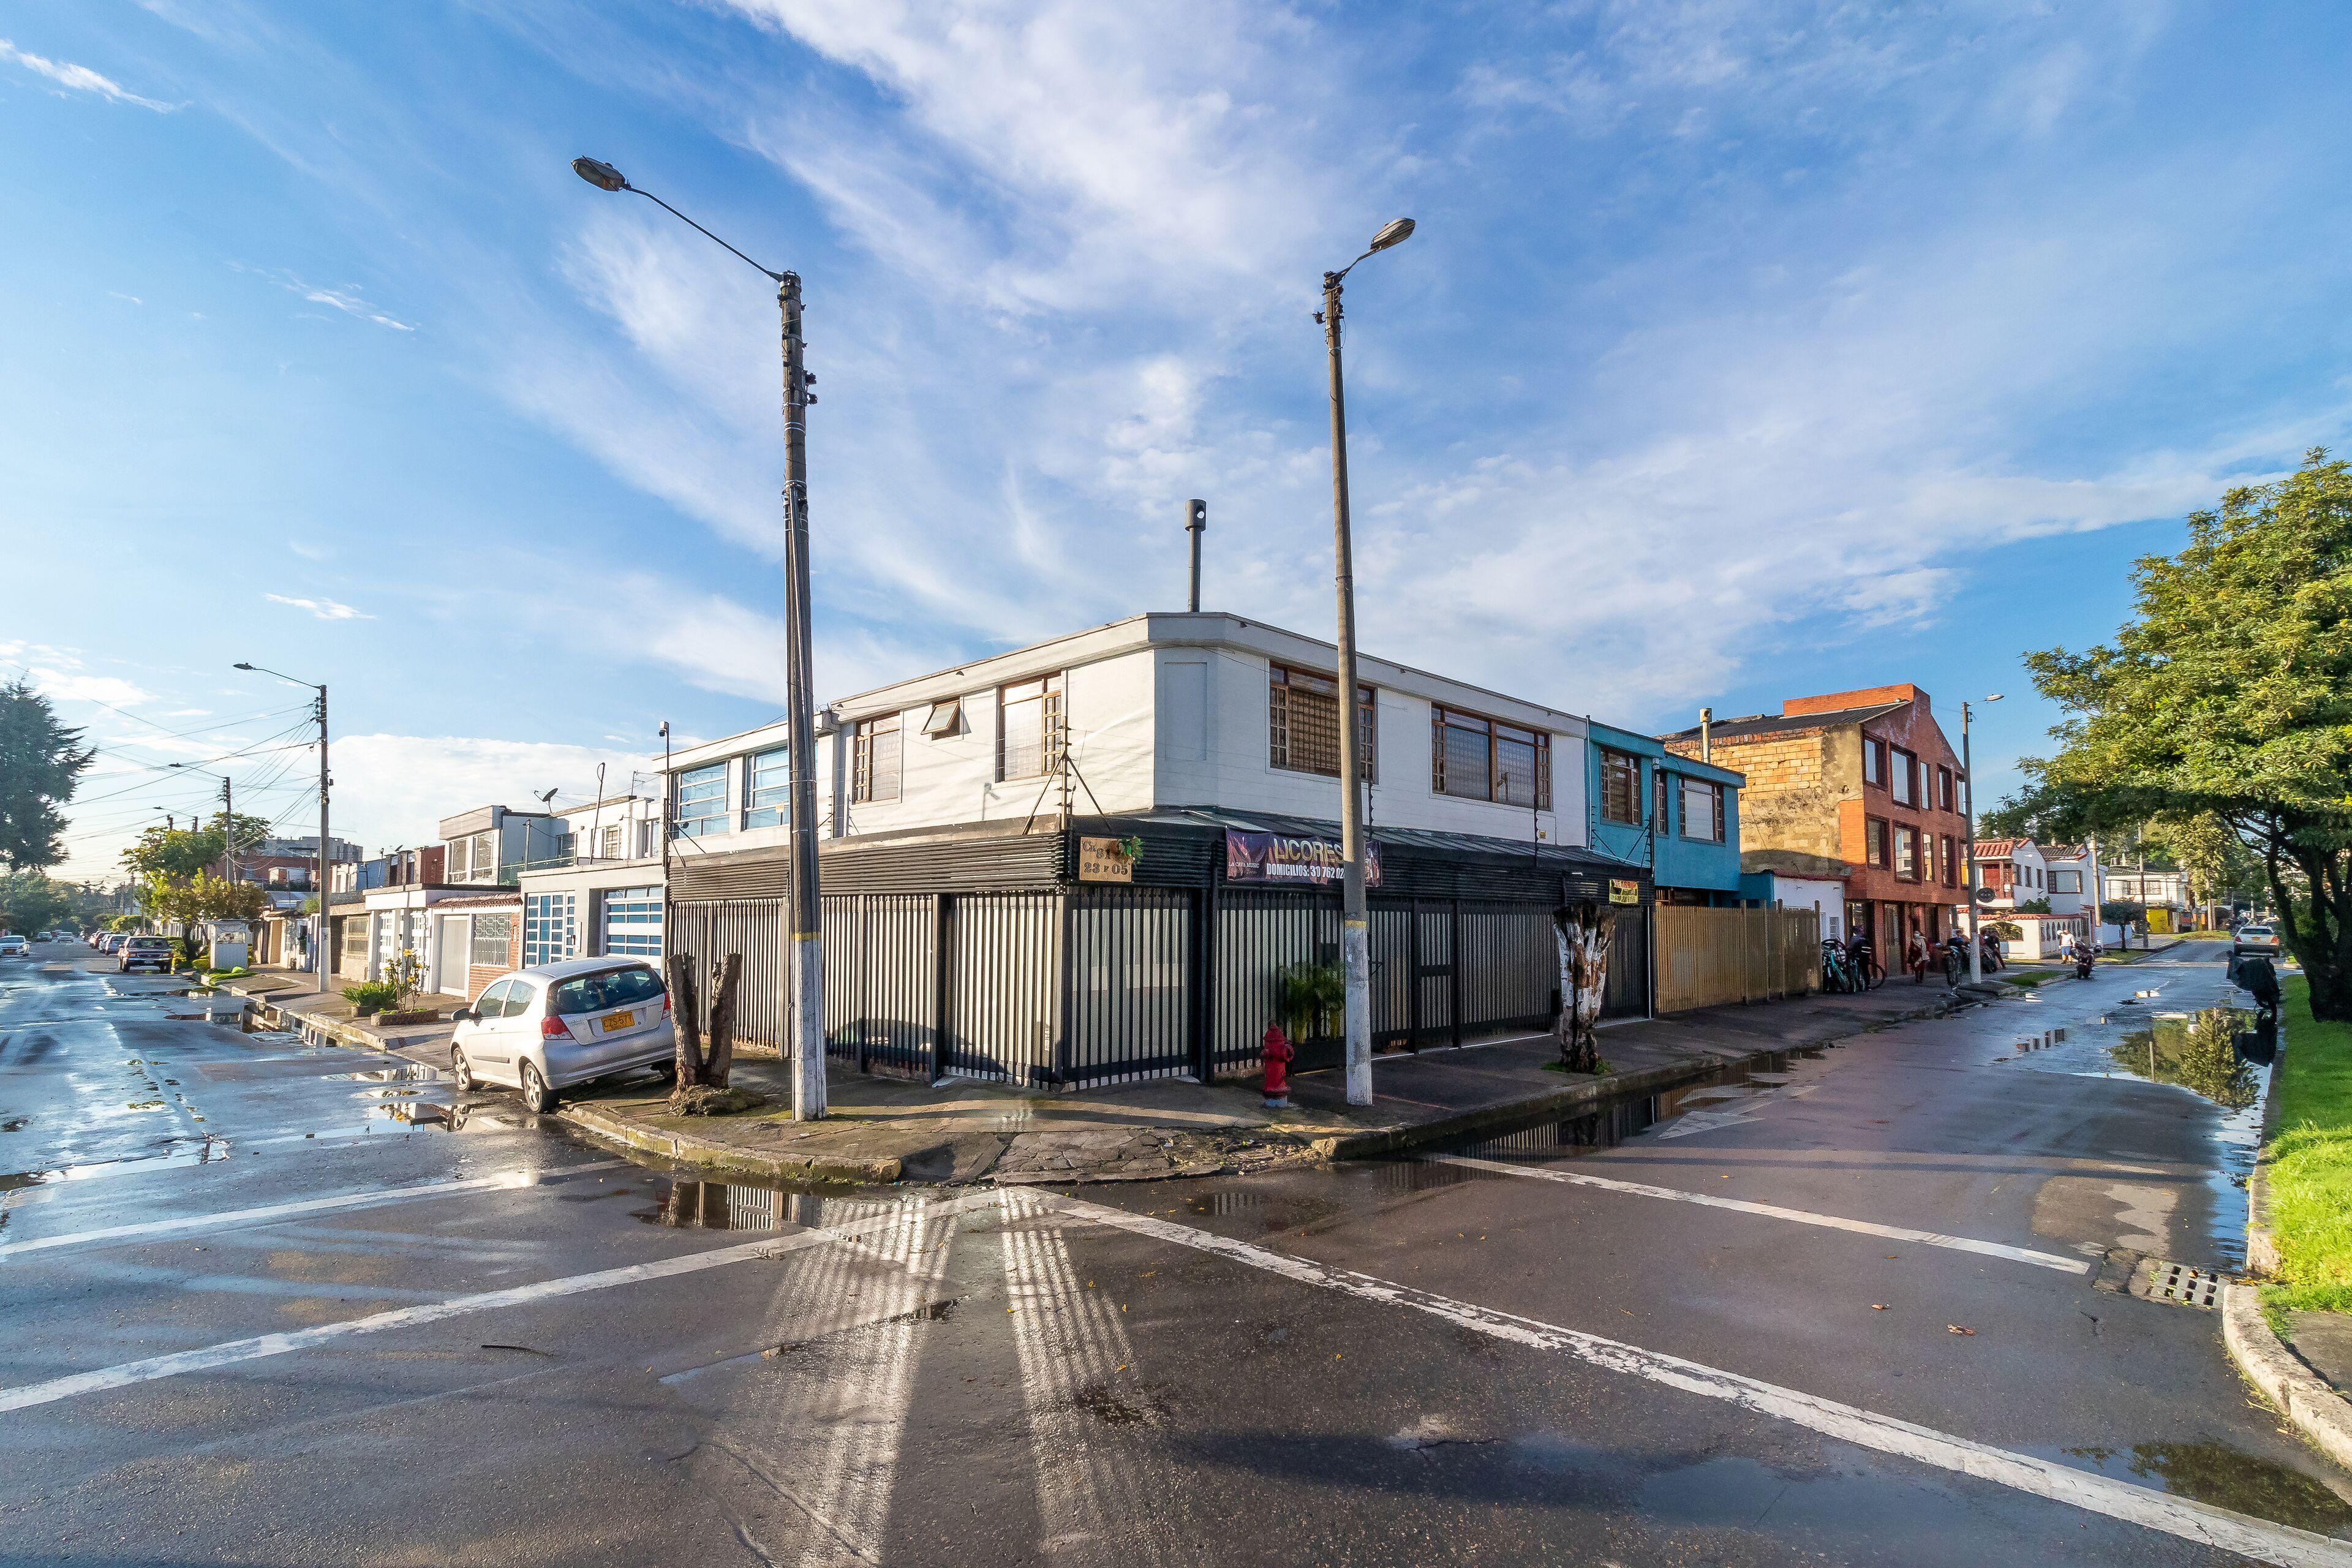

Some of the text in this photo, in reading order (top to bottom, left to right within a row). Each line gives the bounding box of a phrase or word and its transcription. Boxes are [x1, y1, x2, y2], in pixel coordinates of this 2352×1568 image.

[1273, 838, 1344, 864] LICORES
[1084, 861, 1101, 873] 23
[1111, 863, 1128, 875] 05
[1266, 863, 1310, 876] DOMICILIOS:
[1322, 866, 1335, 878] 762
[1336, 867, 1344, 879] 02
